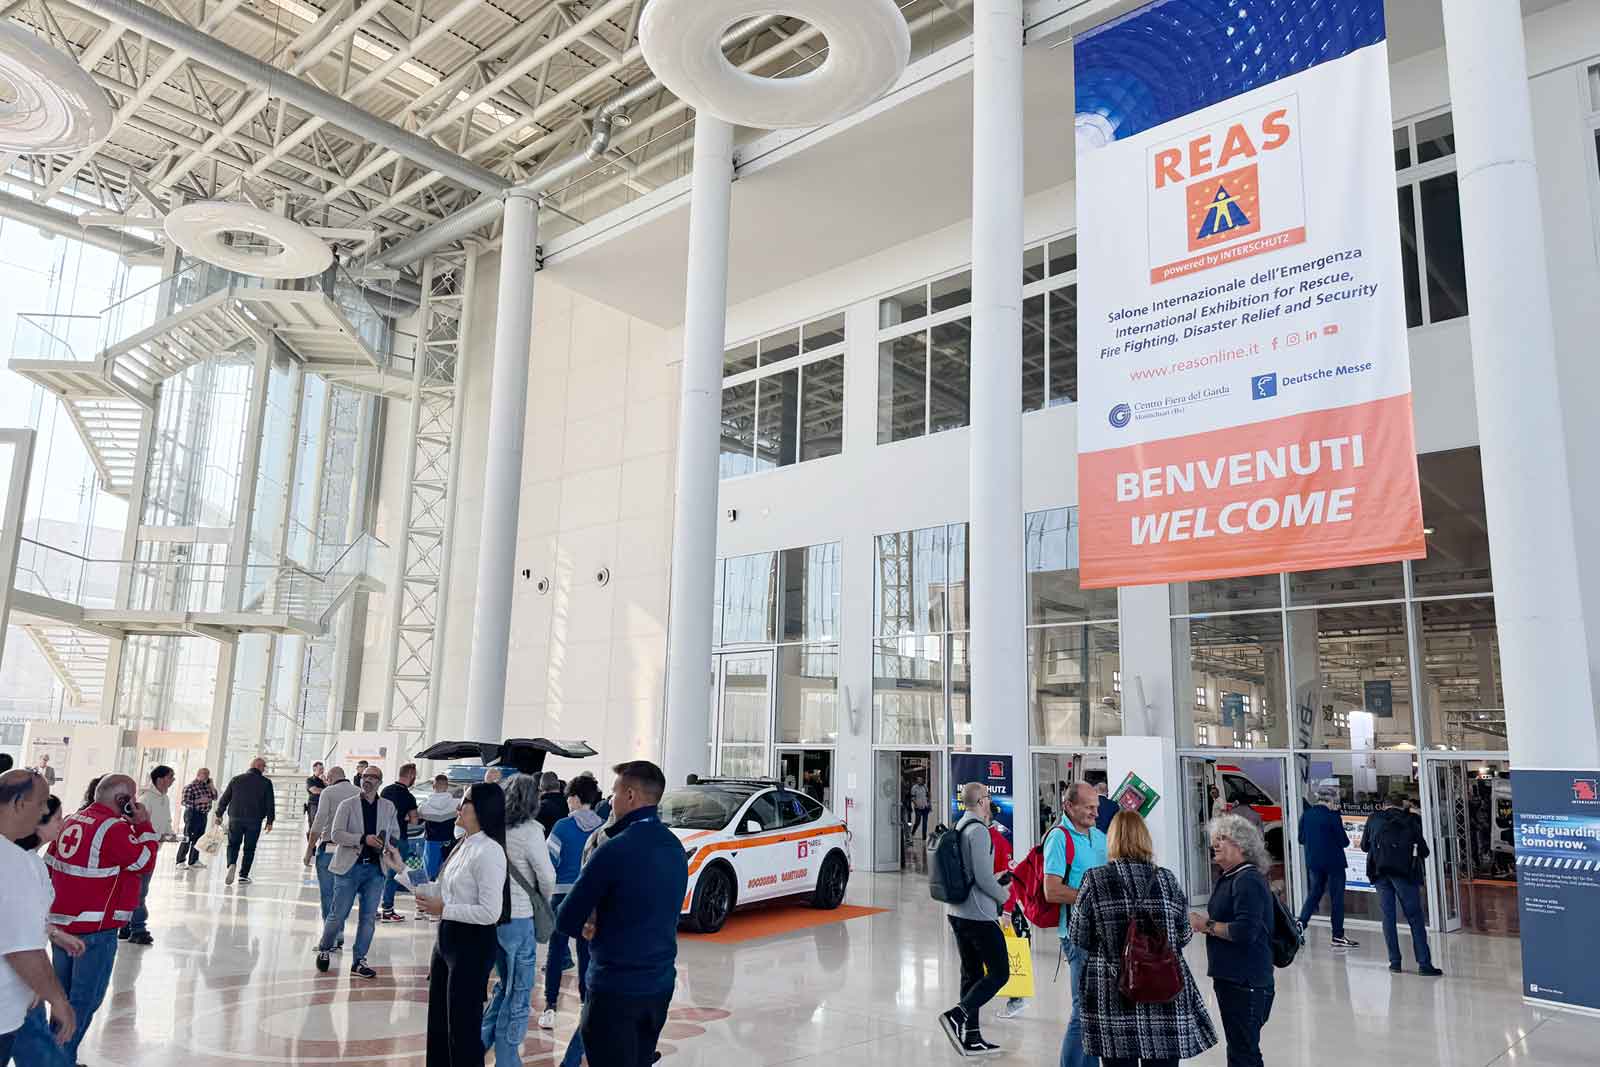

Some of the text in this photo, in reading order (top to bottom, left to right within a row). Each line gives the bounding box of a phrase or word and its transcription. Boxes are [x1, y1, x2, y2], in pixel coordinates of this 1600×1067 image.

[1154, 108, 1290, 189] REAS
[1163, 233, 1289, 279] powered by INTERSCHUTZ
[1100, 282, 1378, 360] Fire Fighting, Disaster Relief and Security
[1107, 304, 1149, 323] Salone
[1152, 277, 1246, 312] Internazionale
[1115, 270, 1355, 338] International Exhibition for Rescue,
[1129, 343, 1260, 382] www.reasonline.it
[1282, 361, 1373, 387] Deutsche Messe
[1134, 385, 1231, 411] Centro Fiera del Garda
[1116, 434, 1365, 502] BENVENUTI
[1130, 486, 1357, 545] WELCOME
[957, 783, 1007, 794] INHUTZ
[1520, 823, 1600, 841] Safeguarding
[1521, 836, 1587, 851] tomorrow.
